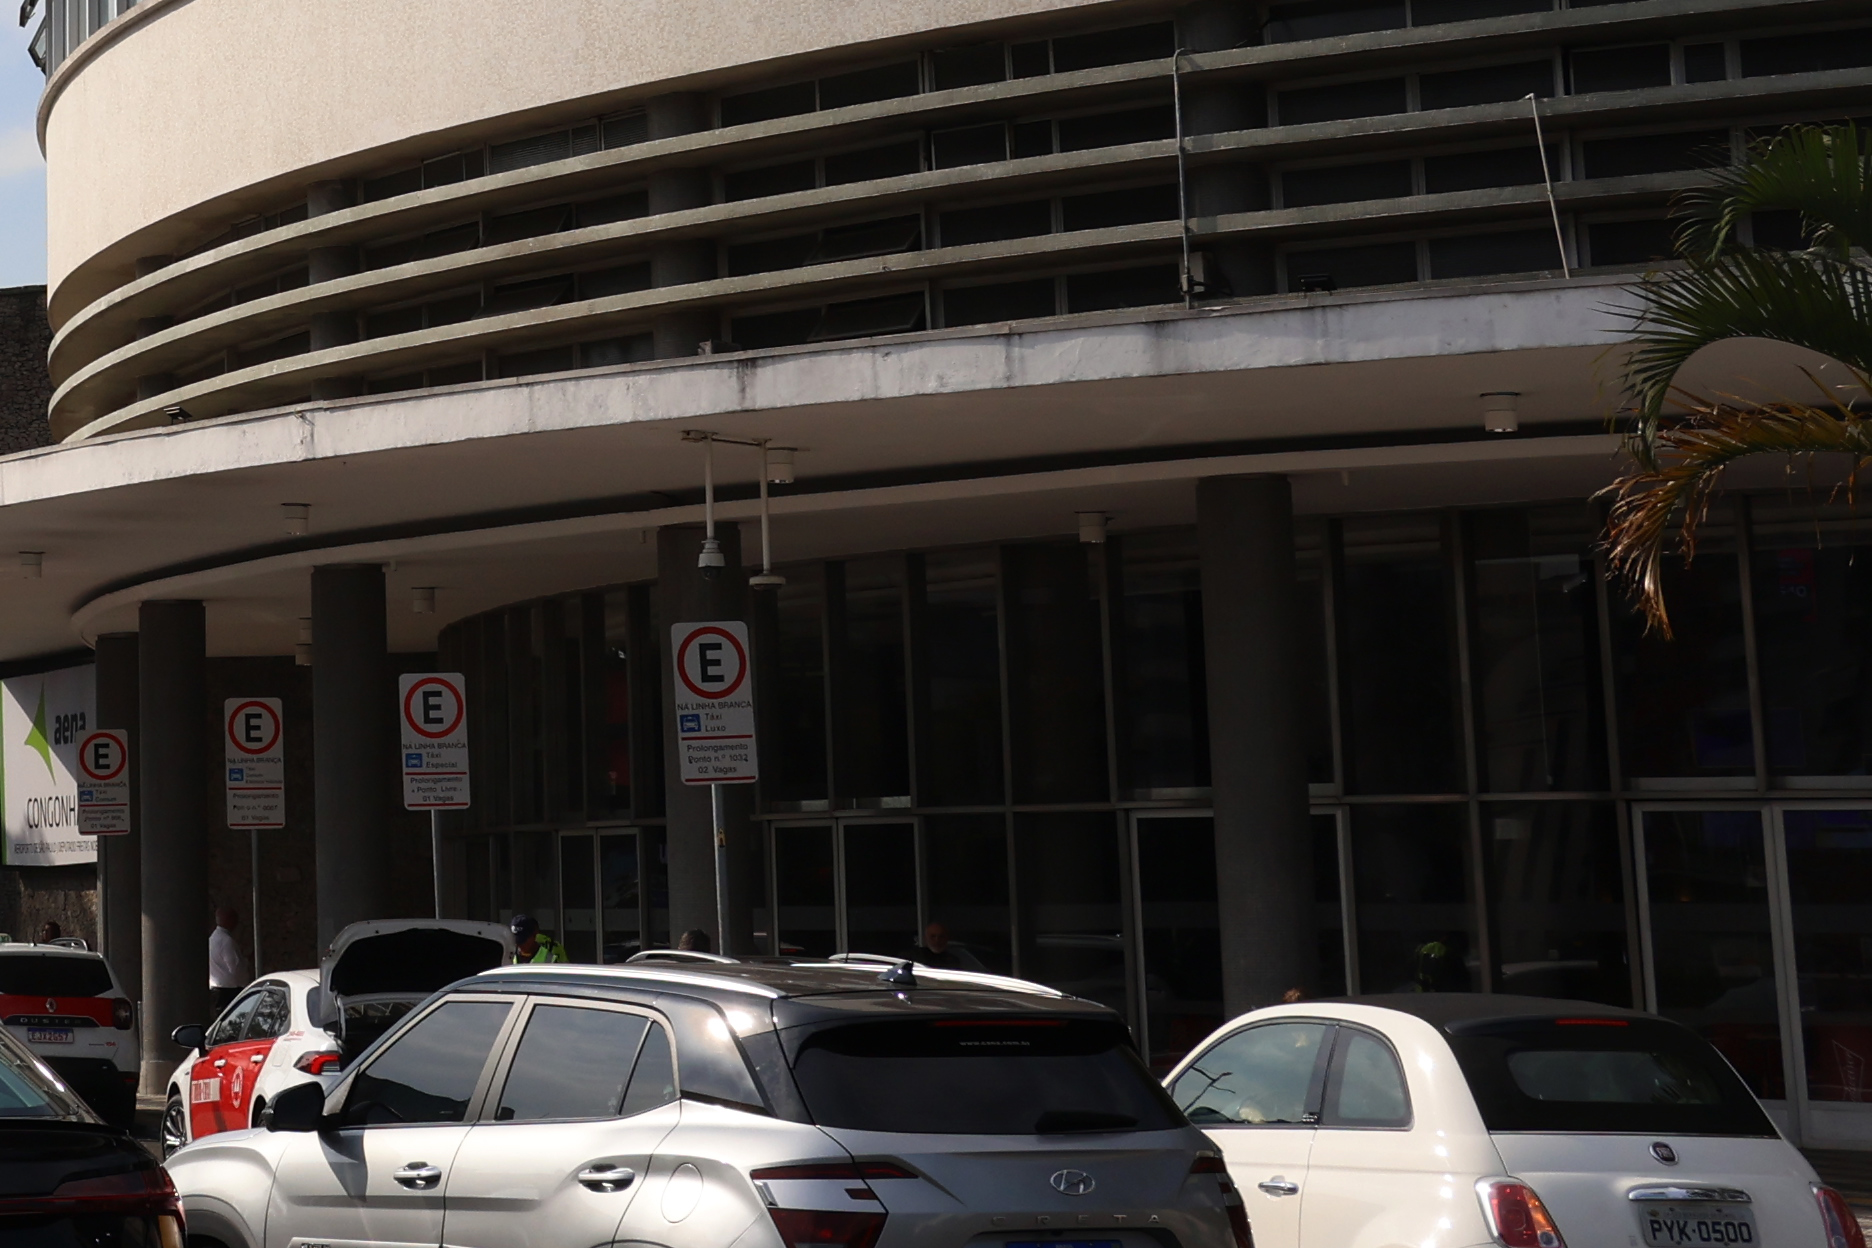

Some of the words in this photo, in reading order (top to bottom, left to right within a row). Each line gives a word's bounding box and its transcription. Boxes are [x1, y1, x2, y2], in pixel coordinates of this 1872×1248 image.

[699, 643, 725, 683] E
[422, 690, 444, 724] E
[678, 703, 690, 711] NA
[691, 703, 717, 711] LINHA
[718, 701, 752, 710] BRANCA
[245, 713, 263, 743] E
[94, 743, 111, 770] E
[687, 744, 748, 753] Prolongamento
[688, 755, 711, 764] Ponto
[698, 766, 709, 774] 02
[712, 766, 737, 775] Vagas
[27, 795, 78, 829] CONGONH
[992, 1214, 1160, 1226] CRETA
